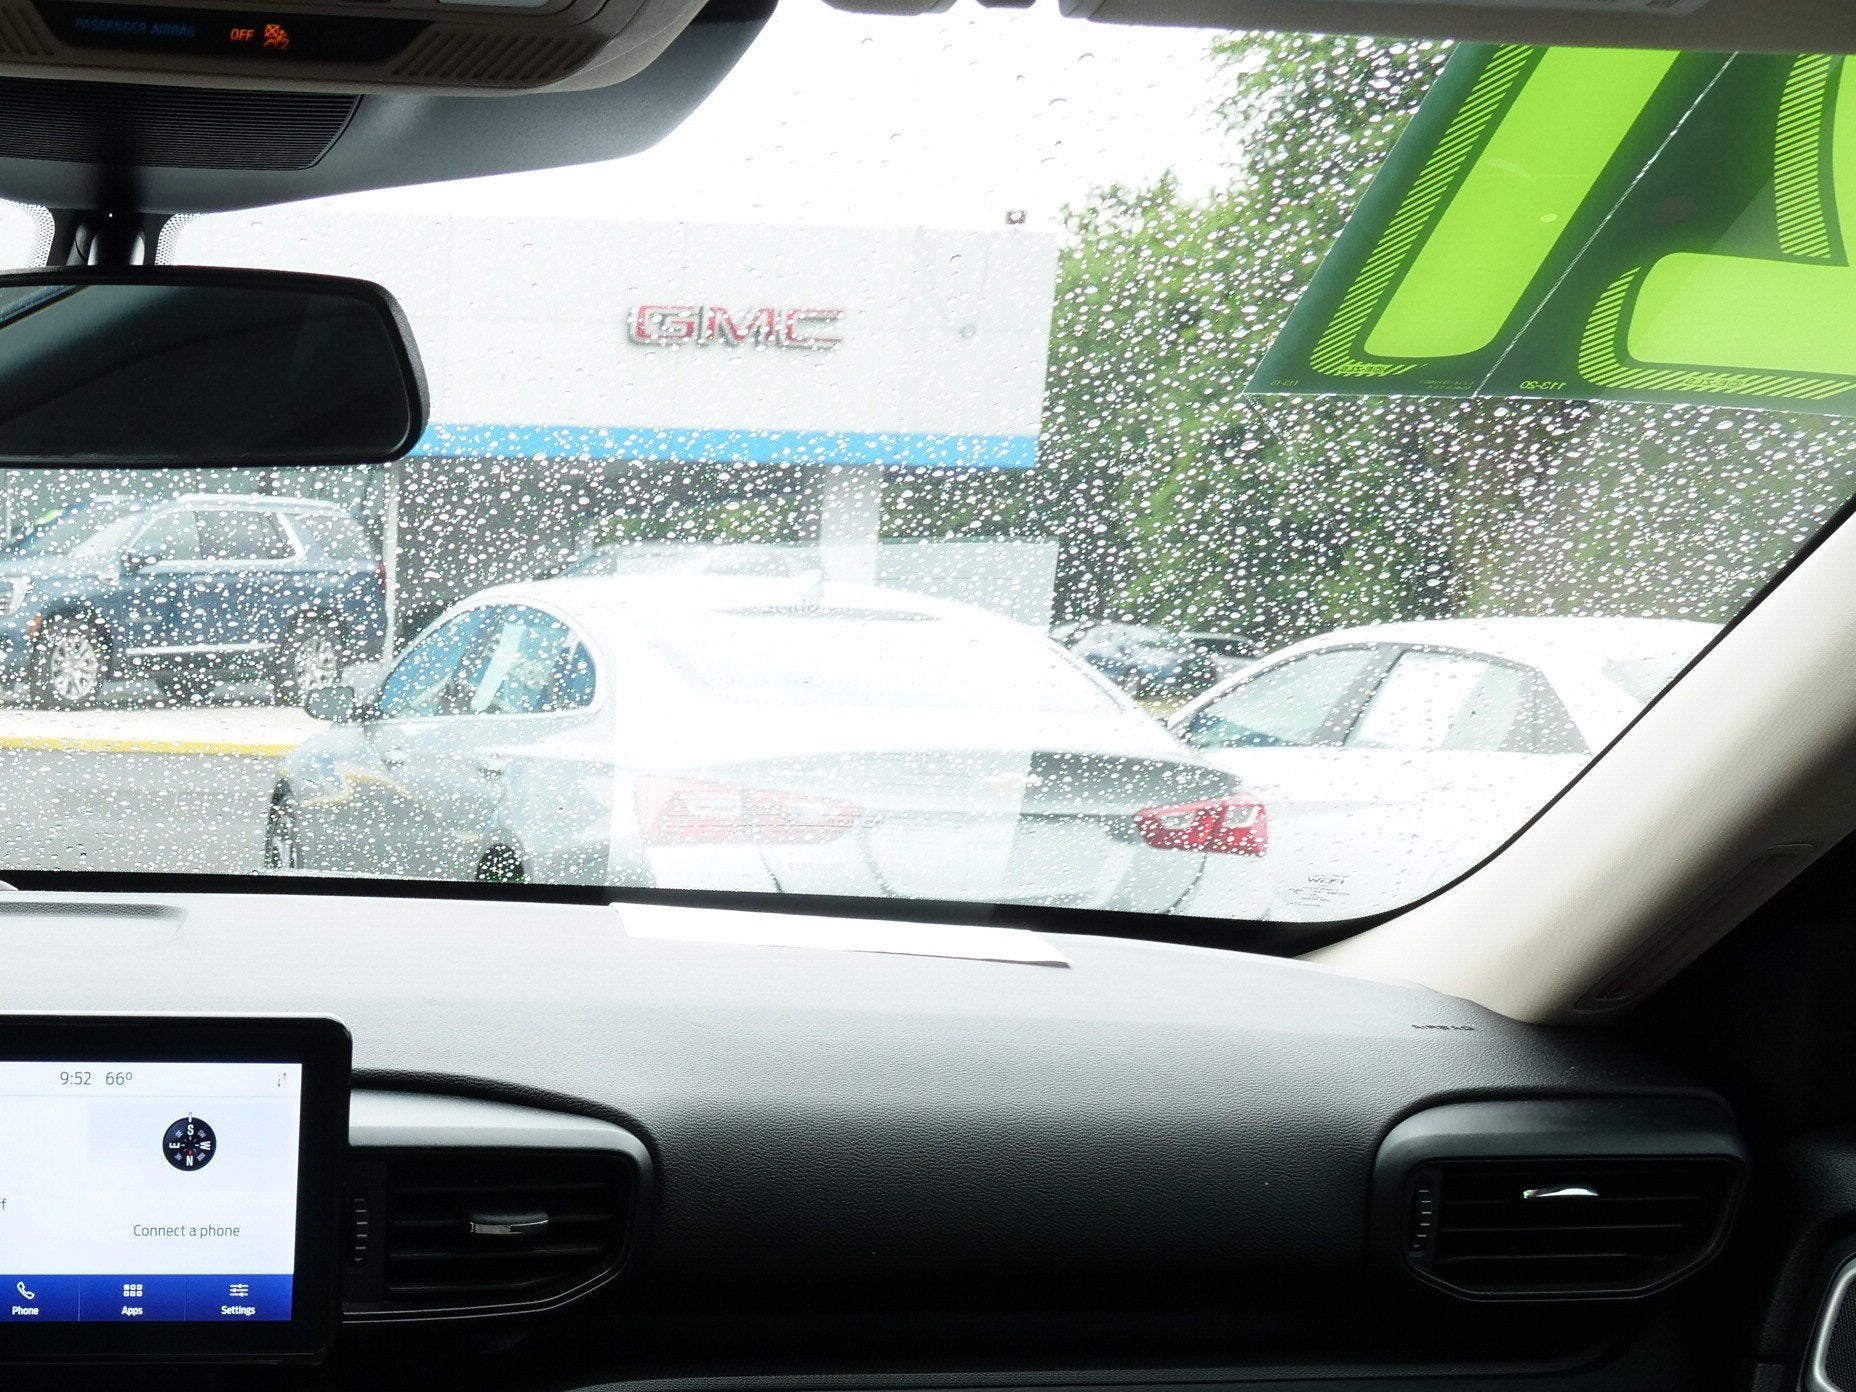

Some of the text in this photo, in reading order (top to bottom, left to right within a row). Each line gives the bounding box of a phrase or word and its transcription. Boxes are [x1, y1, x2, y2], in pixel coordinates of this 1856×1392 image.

[75, 18, 197, 38] PASSENGER AIRBAG
[230, 28, 254, 42] OFF
[630, 303, 845, 350] GMC
[60, 1071, 92, 1086] 9:52
[187, 1124, 194, 1135] S
[200, 1141, 211, 1150] W
[186, 1155, 194, 1167] N
[133, 1223, 240, 1240] Connect a phone
[11, 1305, 40, 1316] Phone
[121, 1305, 143, 1318] Apps
[220, 1304, 256, 1318] Settings
